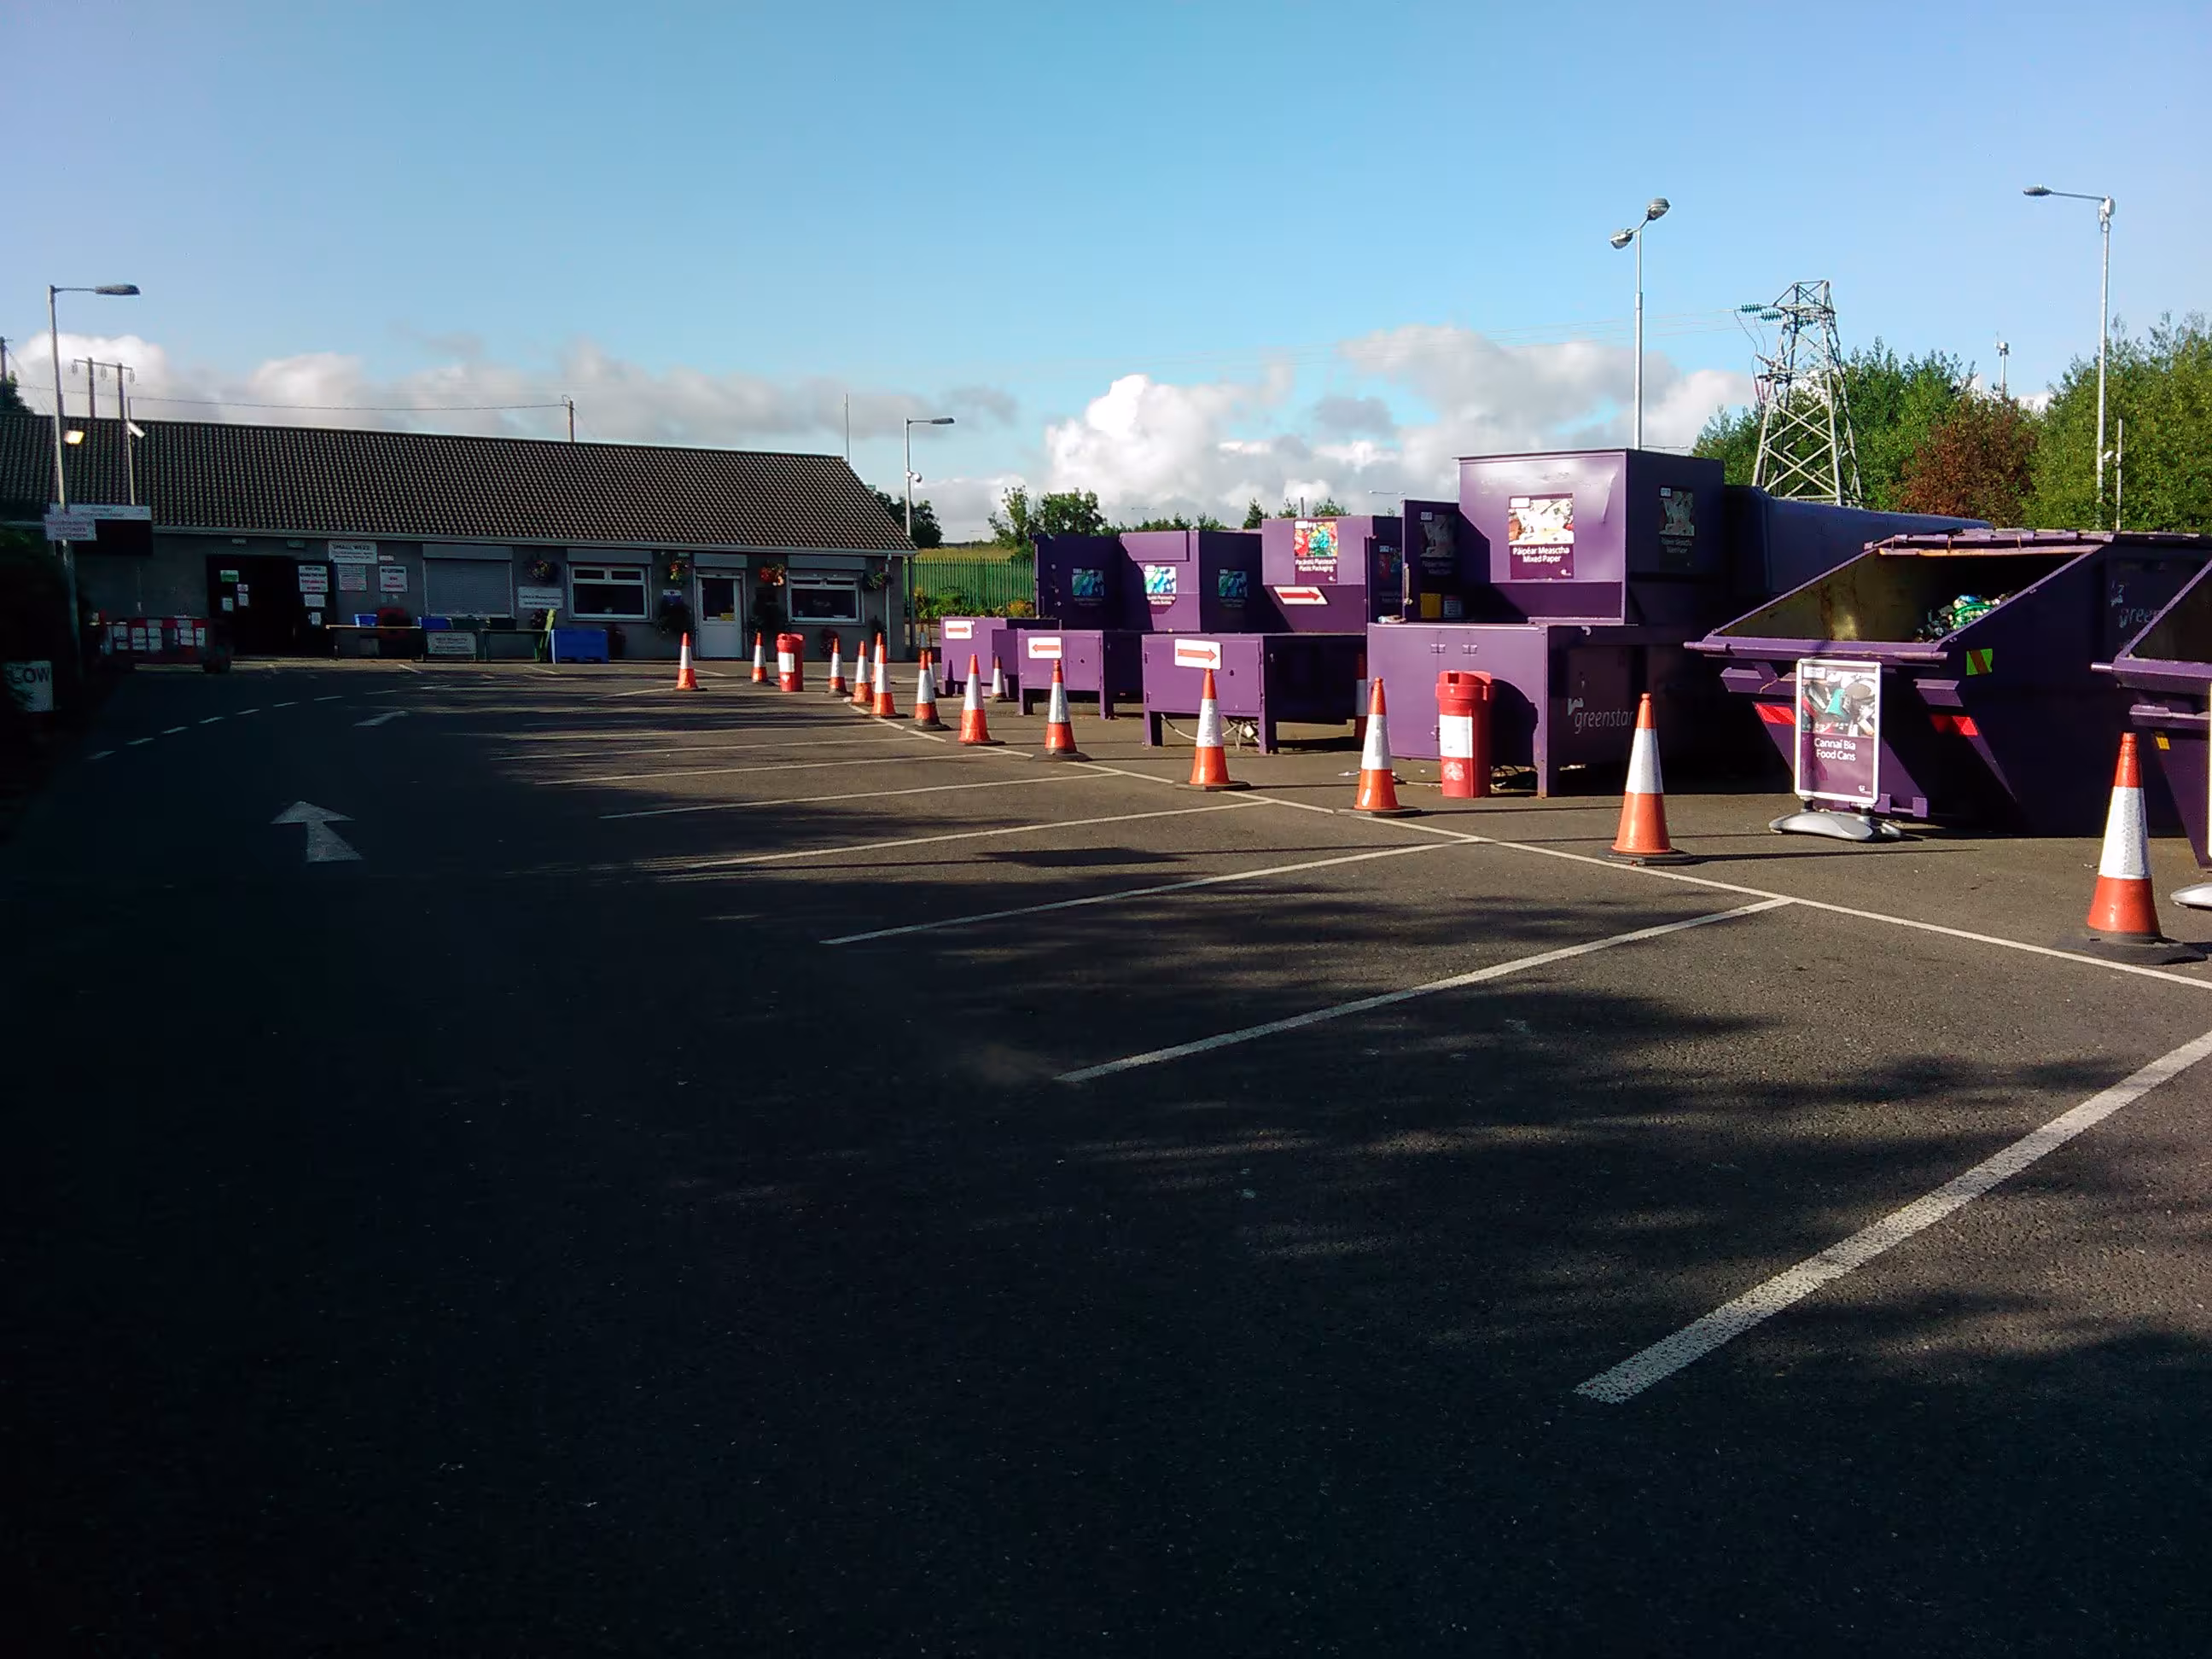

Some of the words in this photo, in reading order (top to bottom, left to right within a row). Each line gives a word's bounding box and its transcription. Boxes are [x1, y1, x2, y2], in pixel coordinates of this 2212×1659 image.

[1543, 556, 1562, 564] Paper
[1574, 707, 1634, 735] greenstar
[1816, 748, 1837, 760] Food
[1837, 750, 1856, 761] Cans
